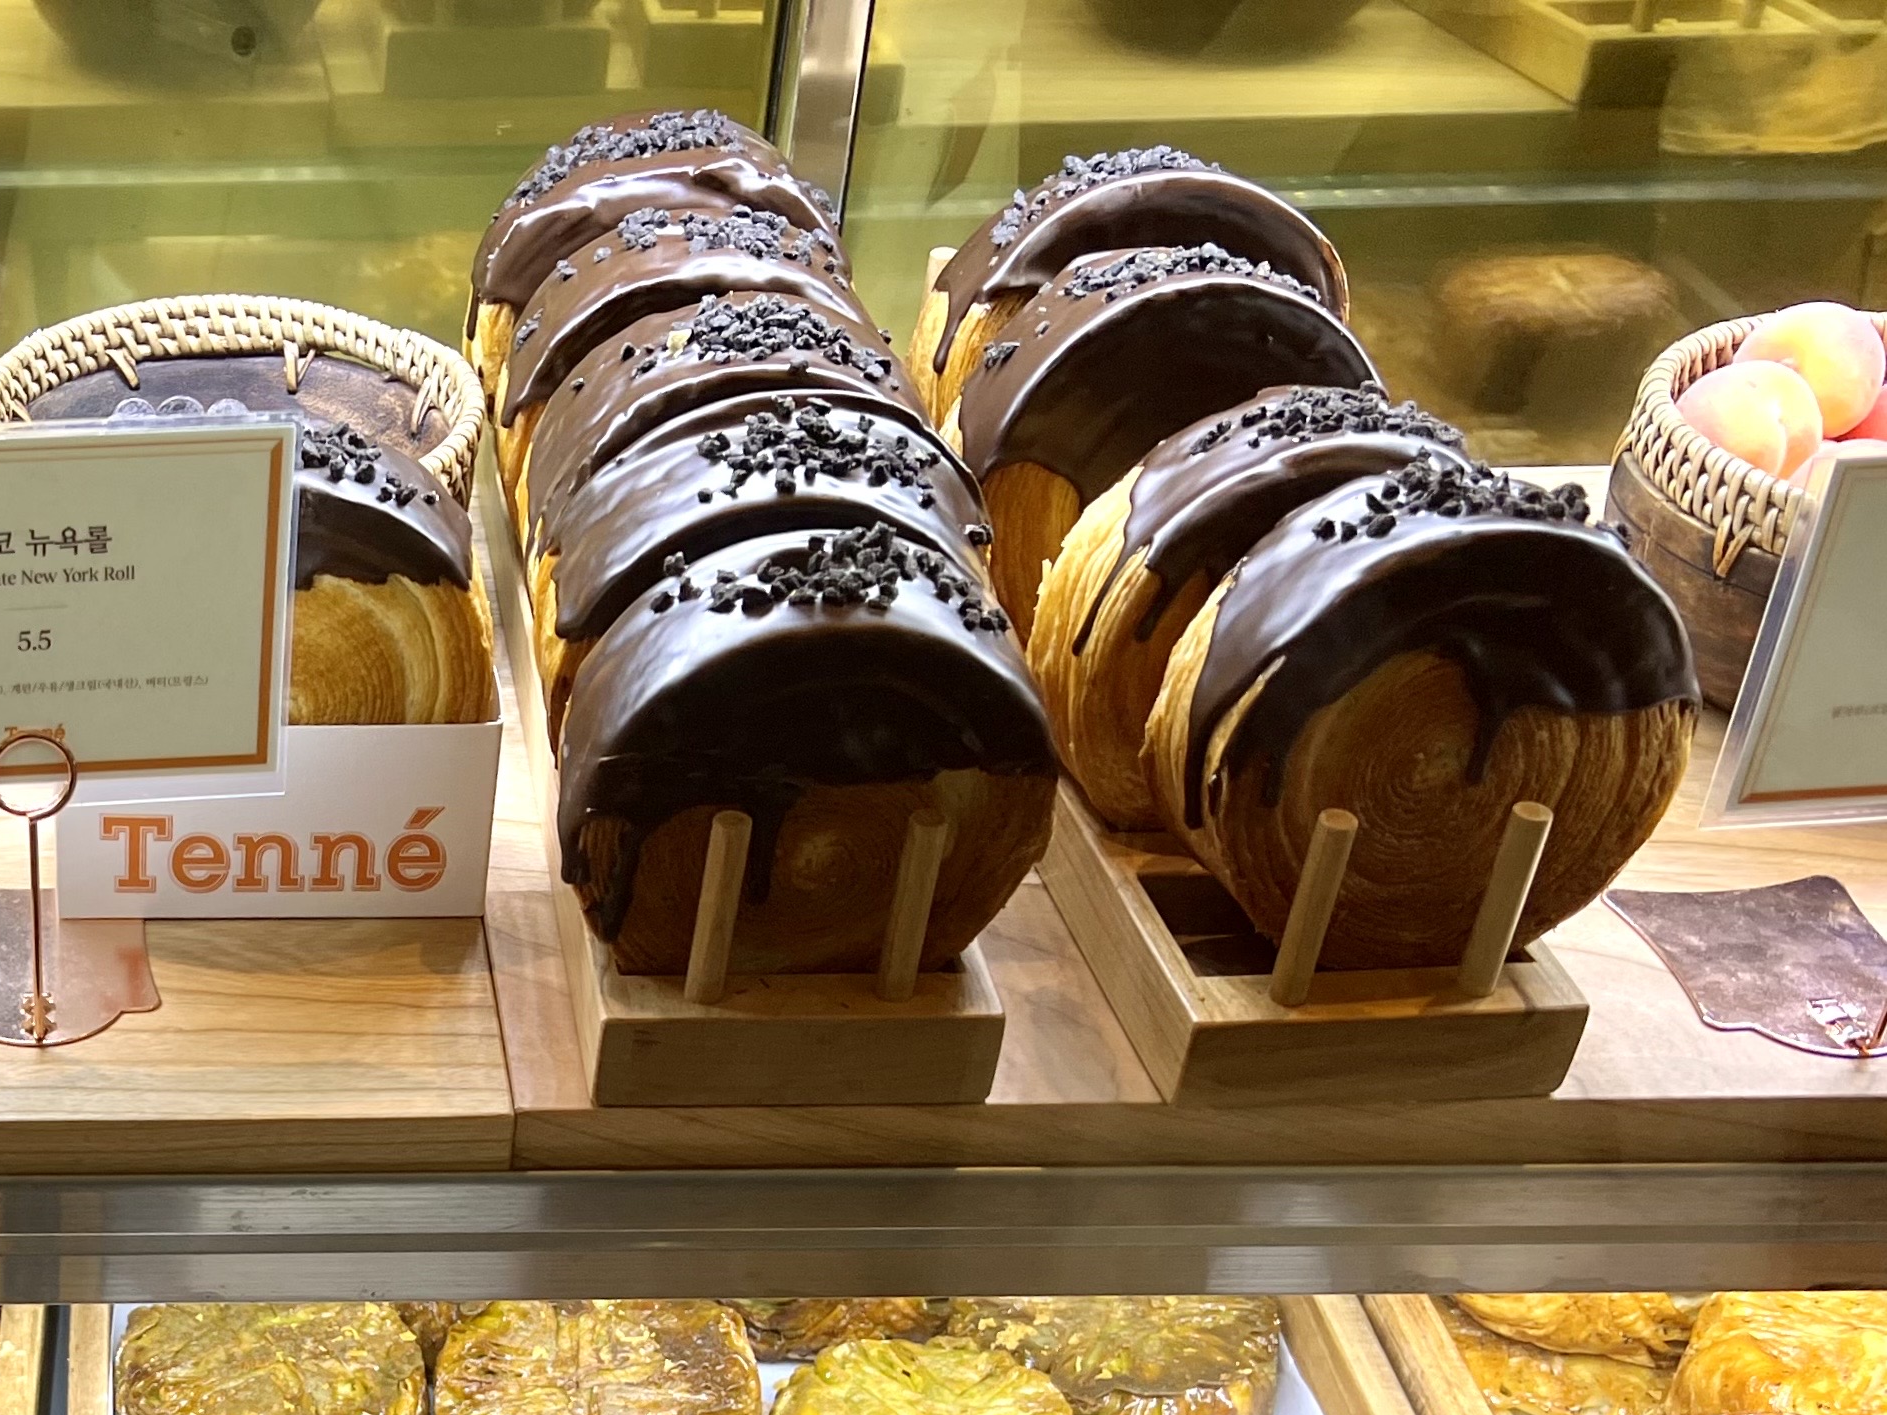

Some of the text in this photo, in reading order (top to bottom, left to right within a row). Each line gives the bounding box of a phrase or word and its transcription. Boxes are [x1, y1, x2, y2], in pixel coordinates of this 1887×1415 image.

[25, 525, 113, 557] 뉴욕롤
[21, 569, 58, 585] New
[63, 567, 99, 583] York
[104, 565, 136, 582] Roll
[17, 629, 53, 652] 5.5
[100, 806, 447, 894] Tenné
